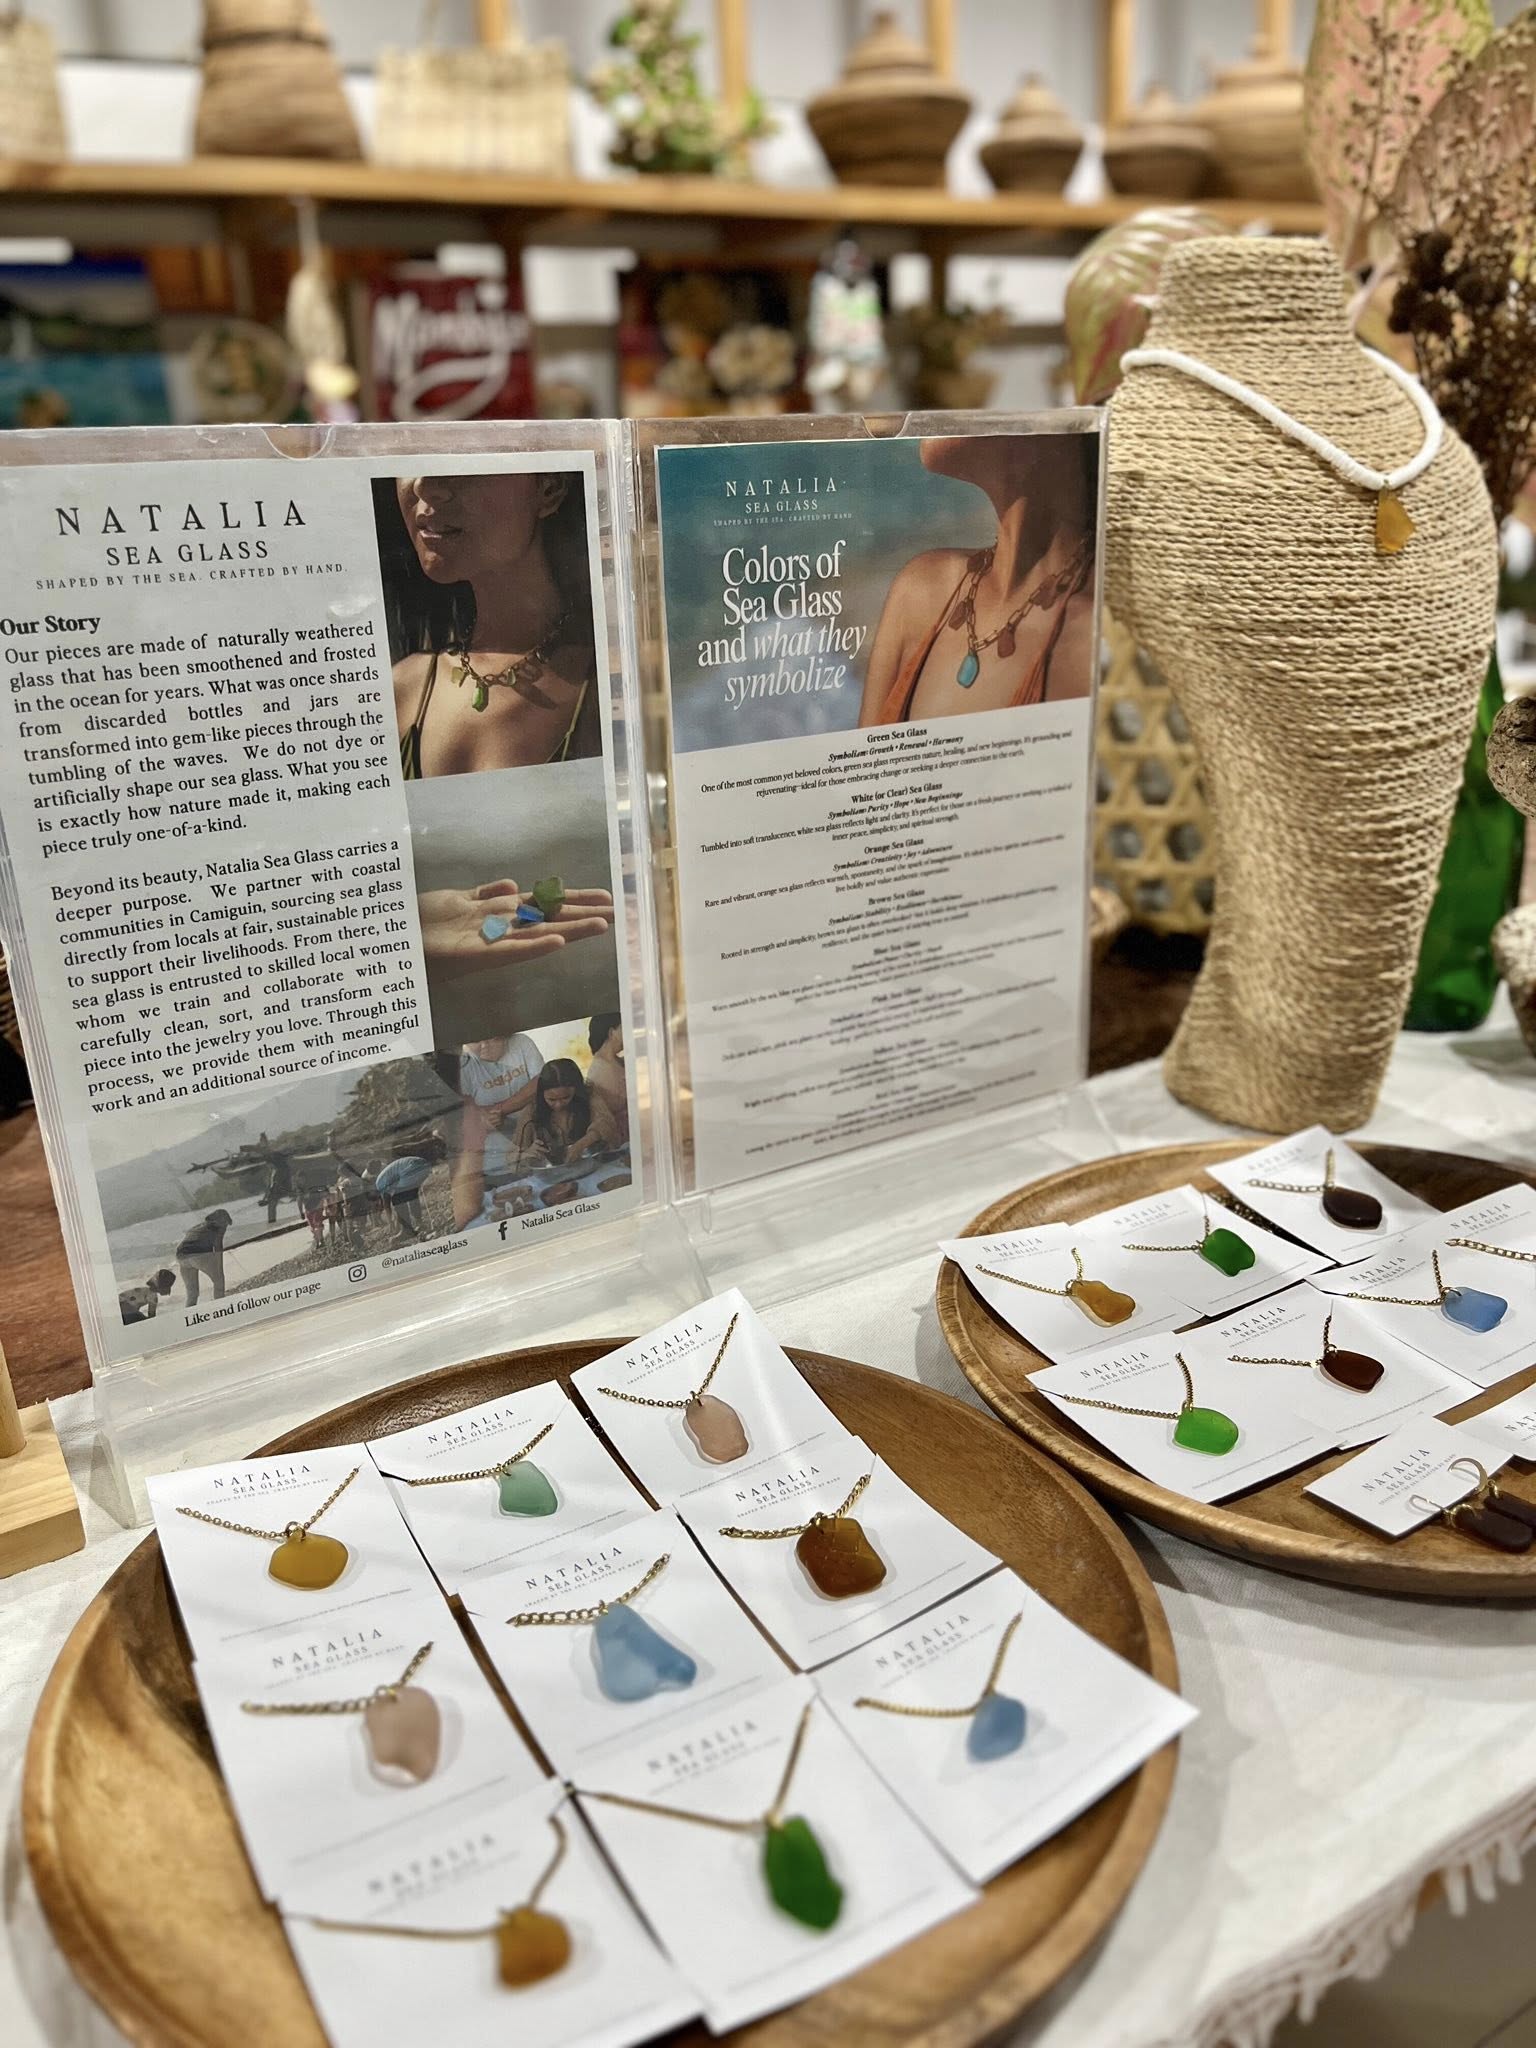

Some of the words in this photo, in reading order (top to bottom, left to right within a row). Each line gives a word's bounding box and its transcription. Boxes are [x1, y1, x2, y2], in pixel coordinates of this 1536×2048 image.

[726, 477, 837, 497] NATALIA
[55, 500, 306, 536] NATALIA
[745, 502, 770, 514] SEA
[776, 498, 818, 511] GLASS
[106, 546, 163, 566] SEA
[178, 540, 268, 562] GLASS
[722, 544, 811, 586] Colors
[816, 539, 846, 579] of
[36, 577, 98, 590] SHAPED
[106, 575, 123, 586] BY
[132, 573, 161, 584] THE
[169, 571, 203, 584] SEA.
[209, 567, 275, 580] CRAFTED
[282, 566, 298, 576] BY
[306, 563, 349, 574] HAND.
[723, 587, 771, 626] Sea
[773, 582, 842, 621] Glass
[0, 618, 40, 636] Our
[44, 615, 101, 635] Story
[4, 648, 39, 664] Our
[45, 645, 101, 665] pieces
[106, 643, 135, 657] are
[140, 635, 186, 654] made
[191, 633, 208, 650] of
[217, 628, 290, 648] naturally
[294, 620, 374, 641] weathered
[698, 627, 748, 667] and
[753, 623, 813, 660] what
[819, 617, 867, 660] they
[9, 671, 54, 693] glass
[60, 667, 97, 685] that
[101, 665, 133, 681] has
[138, 662, 180, 678] been
[186, 650, 283, 675] smoothened
[289, 647, 318, 665] and
[323, 643, 377, 662] frosted
[724, 656, 847, 711] symbolize
[14, 698, 32, 714] in
[35, 695, 65, 712] the
[69, 693, 121, 709] ocean
[124, 687, 149, 703] for
[153, 686, 204, 705] years.
[207, 678, 252, 695] What
[255, 678, 286, 691] was
[289, 674, 326, 688] once
[329, 666, 379, 685] shards
[19, 721, 62, 738] from
[84, 708, 167, 731] discarded
[187, 702, 243, 721] bottles
[262, 696, 291, 713] and
[309, 694, 339, 712] jars
[357, 691, 381, 704] are
[23, 735, 131, 762] transformed
[135, 735, 168, 750] into
[172, 725, 241, 750] gem-like
[245, 723, 293, 742] pieces
[296, 712, 357, 732] through
[360, 710, 384, 726] the
[866, 734, 890, 743] Green
[891, 731, 905, 740] Sea
[906, 728, 928, 738] Glass
[28, 764, 107, 785] tumbling
[114, 758, 132, 775] of
[139, 756, 166, 773] the
[172, 753, 228, 768] waves.
[242, 744, 269, 760] We
[276, 741, 296, 757] do
[303, 739, 328, 754] not
[335, 734, 363, 752] dye
[369, 734, 386, 746] or
[701, 784, 716, 793] One
[716, 781, 724, 791] of
[724, 780, 735, 790] the
[736, 778, 753, 788] most
[753, 774, 783, 785] common
[783, 772, 794, 782] yet
[794, 767, 821, 779] beloved
[821, 765, 843, 775] colors,
[843, 763, 862, 774] green
[862, 761, 873, 769] sea
[873, 758, 889, 769] glass
[33, 784, 121, 809] artificially
[126, 781, 174, 798] shape
[178, 777, 206, 791] our
[211, 774, 237, 787] sea
[241, 767, 283, 787] glass.
[286, 760, 329, 777] What
[332, 759, 360, 776] you
[364, 756, 388, 768] see
[851, 793, 874, 804] White
[874, 791, 886, 801] (or
[886, 786, 909, 798] Clear)
[909, 786, 923, 794] Sea
[923, 782, 943, 792] Glass
[37, 818, 53, 833] is
[59, 808, 121, 830] exactly
[127, 805, 162, 821] how
[168, 799, 222, 815] nature
[228, 789, 270, 808] made
[276, 787, 292, 803] it,
[297, 781, 352, 799] making
[356, 773, 391, 791] each
[42, 839, 87, 859] piece
[91, 830, 132, 849] truly
[136, 814, 247, 842] one-of-a-kind.
[50, 876, 115, 901] Beyond
[118, 876, 139, 890] its
[142, 869, 203, 887] beauty,
[205, 858, 260, 878] Natalia
[263, 855, 291, 869] Sea
[294, 848, 334, 865] Glass
[337, 841, 388, 858] carries
[390, 840, 399, 851] a
[521, 1213, 555, 1230] Natalia
[555, 1209, 574, 1220] Sea
[574, 1202, 601, 1214] Glass
[381, 1239, 468, 1269] @nataliaseaglass
[184, 1313, 210, 1327] Like
[212, 1303, 235, 1319] and
[237, 1296, 270, 1313] follow
[273, 1290, 293, 1302] our
[294, 1282, 321, 1299] page
[1220, 1307, 1286, 1338] NATALIA
[1239, 1329, 1257, 1338] SEA
[1256, 1317, 1283, 1331] GLASS
[626, 1324, 703, 1369] NATALIA
[644, 1357, 663, 1370] SEA
[665, 1339, 695, 1358] GLASS
[1080, 1352, 1149, 1379] NATALIA
[1100, 1372, 1118, 1381] SEA
[1118, 1363, 1146, 1375] GLASS
[427, 1409, 514, 1444] NATALIA
[446, 1435, 467, 1446] SEA
[470, 1422, 504, 1437] GLASS
[213, 1465, 310, 1489] NATALIA
[232, 1485, 255, 1494] SEA
[260, 1478, 297, 1490] GLASS
[735, 1466, 820, 1502] NATALIA
[1362, 1449, 1430, 1492] NATALIA
[1385, 1480, 1405, 1492] SEA
[1403, 1462, 1431, 1481] GLASS
[756, 1493, 777, 1504] SEA
[779, 1480, 812, 1496] GLASS
[525, 1547, 622, 1589] NATALIA
[547, 1580, 571, 1592] SEA
[574, 1563, 612, 1582] GLASS
[272, 1628, 382, 1668] NATALIA
